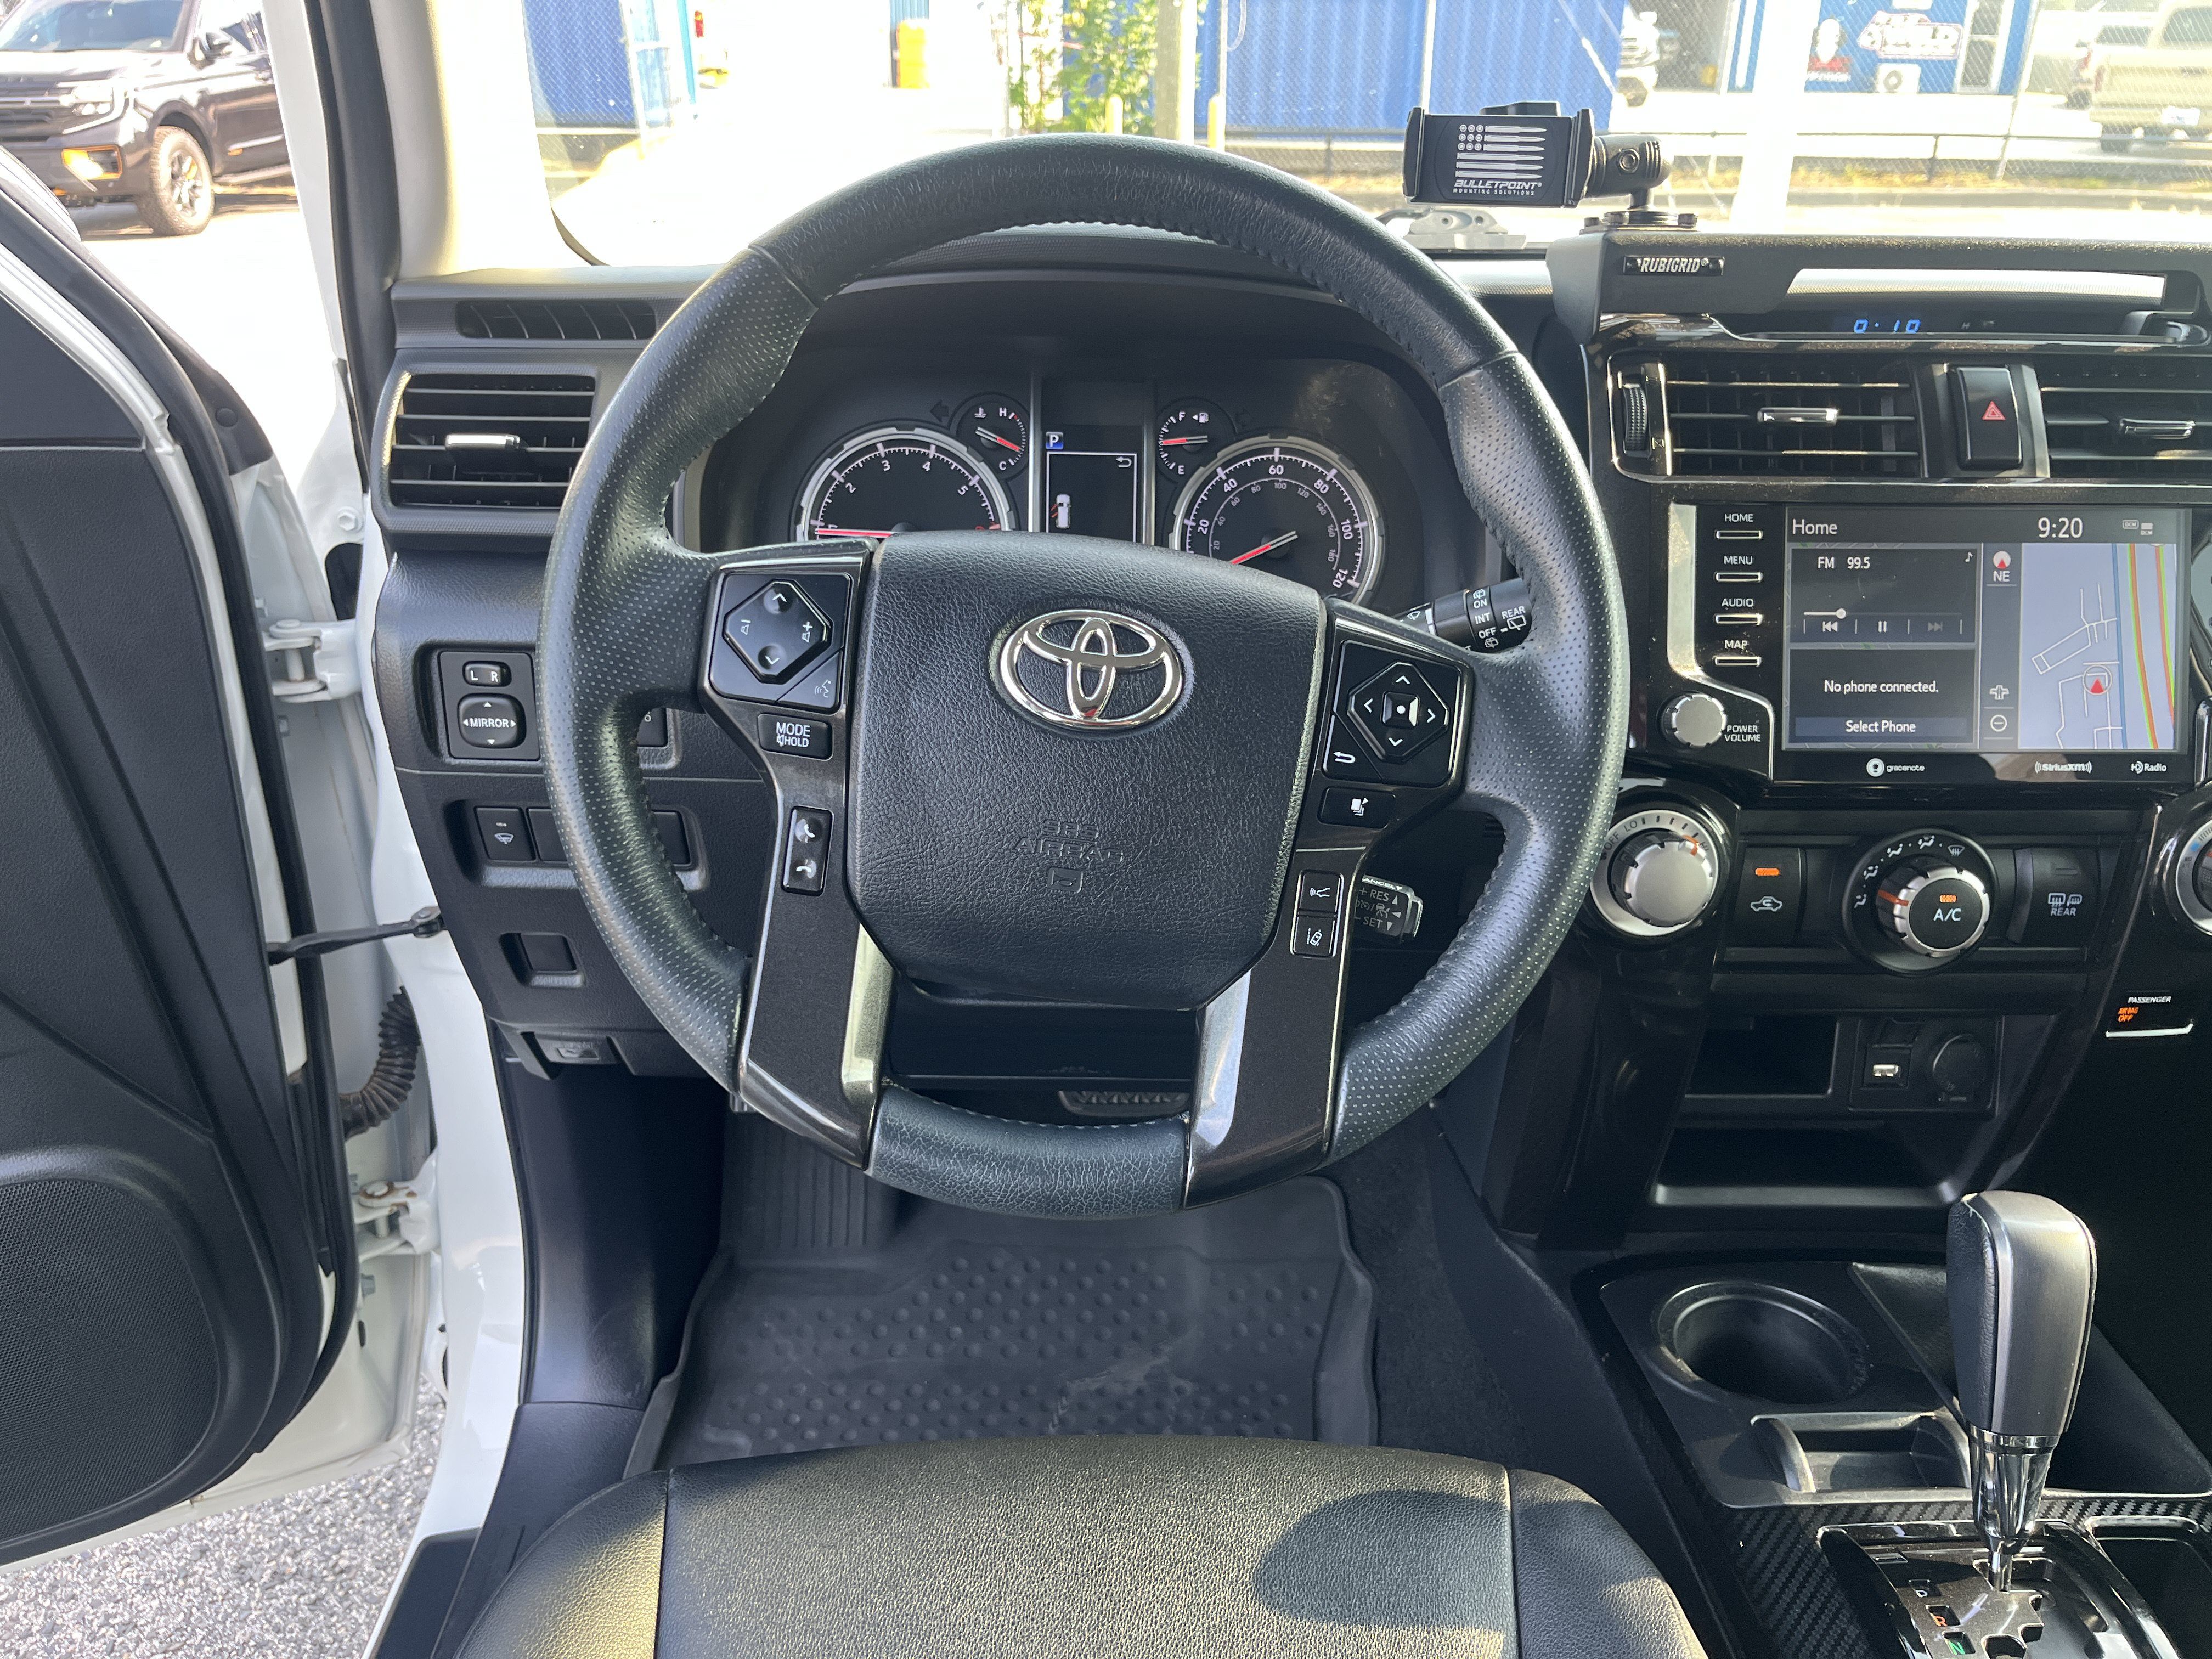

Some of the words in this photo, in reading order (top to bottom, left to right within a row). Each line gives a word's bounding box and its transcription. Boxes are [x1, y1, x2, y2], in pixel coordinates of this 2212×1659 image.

[999, 408, 1007, 417] H
[1178, 411, 1186, 421] F
[1049, 435, 1059, 447] P
[882, 460, 891, 471] 3
[922, 461, 932, 472] 4
[998, 461, 1006, 471] C
[1178, 465, 1185, 475] E
[1268, 465, 1284, 476] 60
[845, 482, 856, 494] 2
[957, 484, 969, 496] 5
[1223, 478, 1238, 493] 40
[1250, 484, 1261, 494] 80
[1274, 482, 1286, 490] 100
[1313, 478, 1330, 494] 80
[1296, 487, 1310, 499] 120
[1230, 496, 1241, 506] 60
[1316, 503, 1327, 516] 140
[1217, 516, 1226, 527] 40
[1724, 514, 1753, 522] HOME
[1197, 519, 1210, 535] 20
[1327, 524, 1335, 538] 160
[1340, 518, 1353, 540] 100
[1792, 519, 1838, 535] Home
[2038, 517, 2083, 538] 9:20
[1213, 540, 1220, 550] 20
[1327, 549, 1335, 563] 180
[1724, 556, 1753, 565] MENU
[1818, 557, 1835, 569] FM
[1847, 557, 1871, 569] 99.5
[1332, 568, 1349, 589] 120
[1993, 571, 2010, 582] NE
[1474, 598, 1488, 608] ON
[1722, 598, 1754, 607] AUDIO
[1474, 612, 1491, 624] INT
[1501, 605, 1526, 619] REAR
[1478, 627, 1496, 639] OFF
[1724, 640, 1748, 649] MAP
[470, 670, 479, 681] L
[490, 671, 499, 682] R
[1824, 680, 1841, 692] No
[1844, 680, 1877, 696] phone
[1880, 680, 1939, 693] connected.
[469, 718, 510, 728] MIRROR
[776, 721, 811, 737] MODE
[1726, 725, 1758, 733] POWER
[1846, 720, 1879, 733] Select
[1881, 720, 1916, 733] Phone
[784, 736, 809, 748] HOLD
[1724, 733, 1761, 742] VOLUME
[2145, 763, 2167, 771] Radio
[1624, 820, 1638, 832] LO
[1604, 831, 1619, 851] OFF
[1015, 838, 1124, 864] AIRBAG
[1362, 878, 1396, 889] ANCEL
[1369, 889, 1390, 901] RES
[1933, 908, 1962, 922] A/C
[2050, 907, 2076, 917] REAR
[1363, 916, 1384, 928] SET
[1930, 1615, 1948, 1627] R
[1949, 1641, 1966, 1656] N
